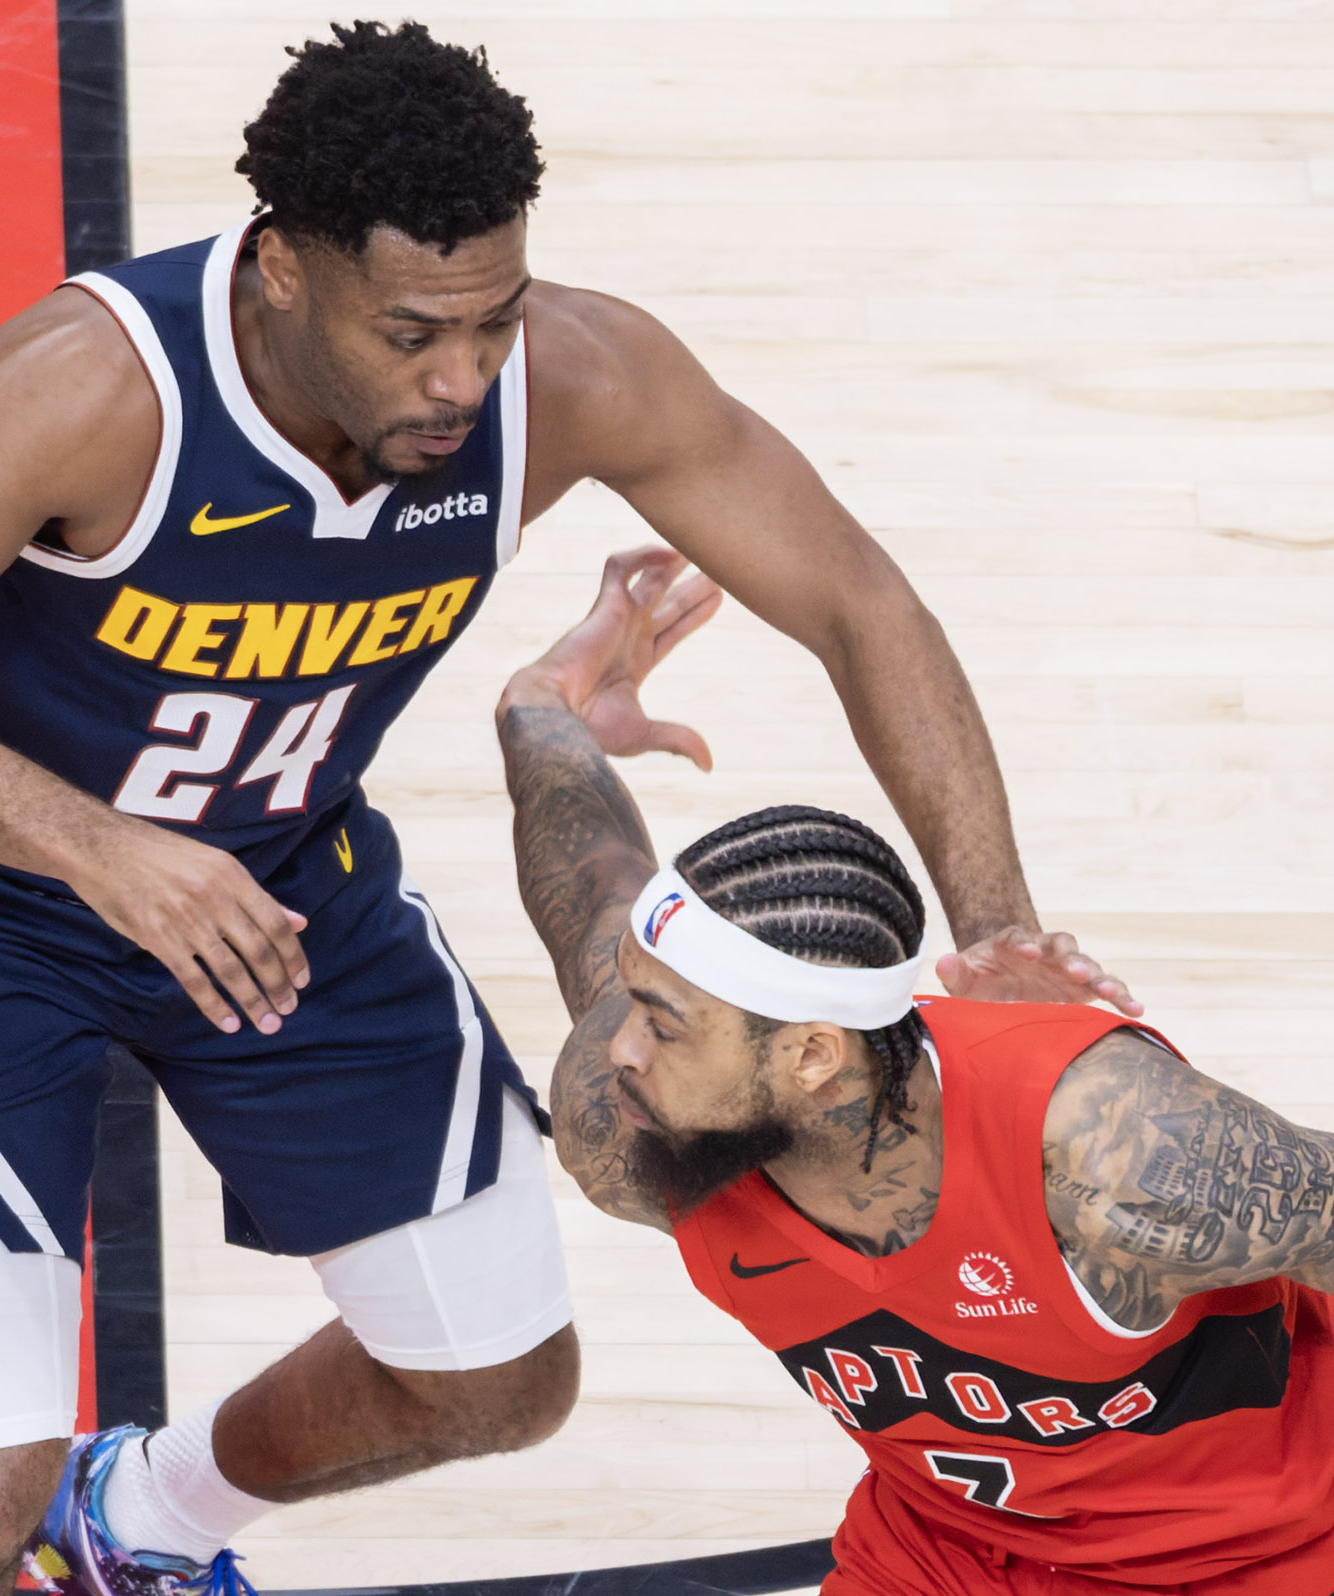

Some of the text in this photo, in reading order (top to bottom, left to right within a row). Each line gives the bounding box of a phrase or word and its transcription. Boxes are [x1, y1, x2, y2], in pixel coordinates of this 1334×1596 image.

[395, 491, 488, 532] ibotta
[94, 575, 481, 680] DENVER
[112, 682, 358, 825] 24
[955, 1297, 1039, 1318] Sun Life
[802, 1344, 1158, 1437] APTORS
[923, 1449, 1017, 1512] 7
